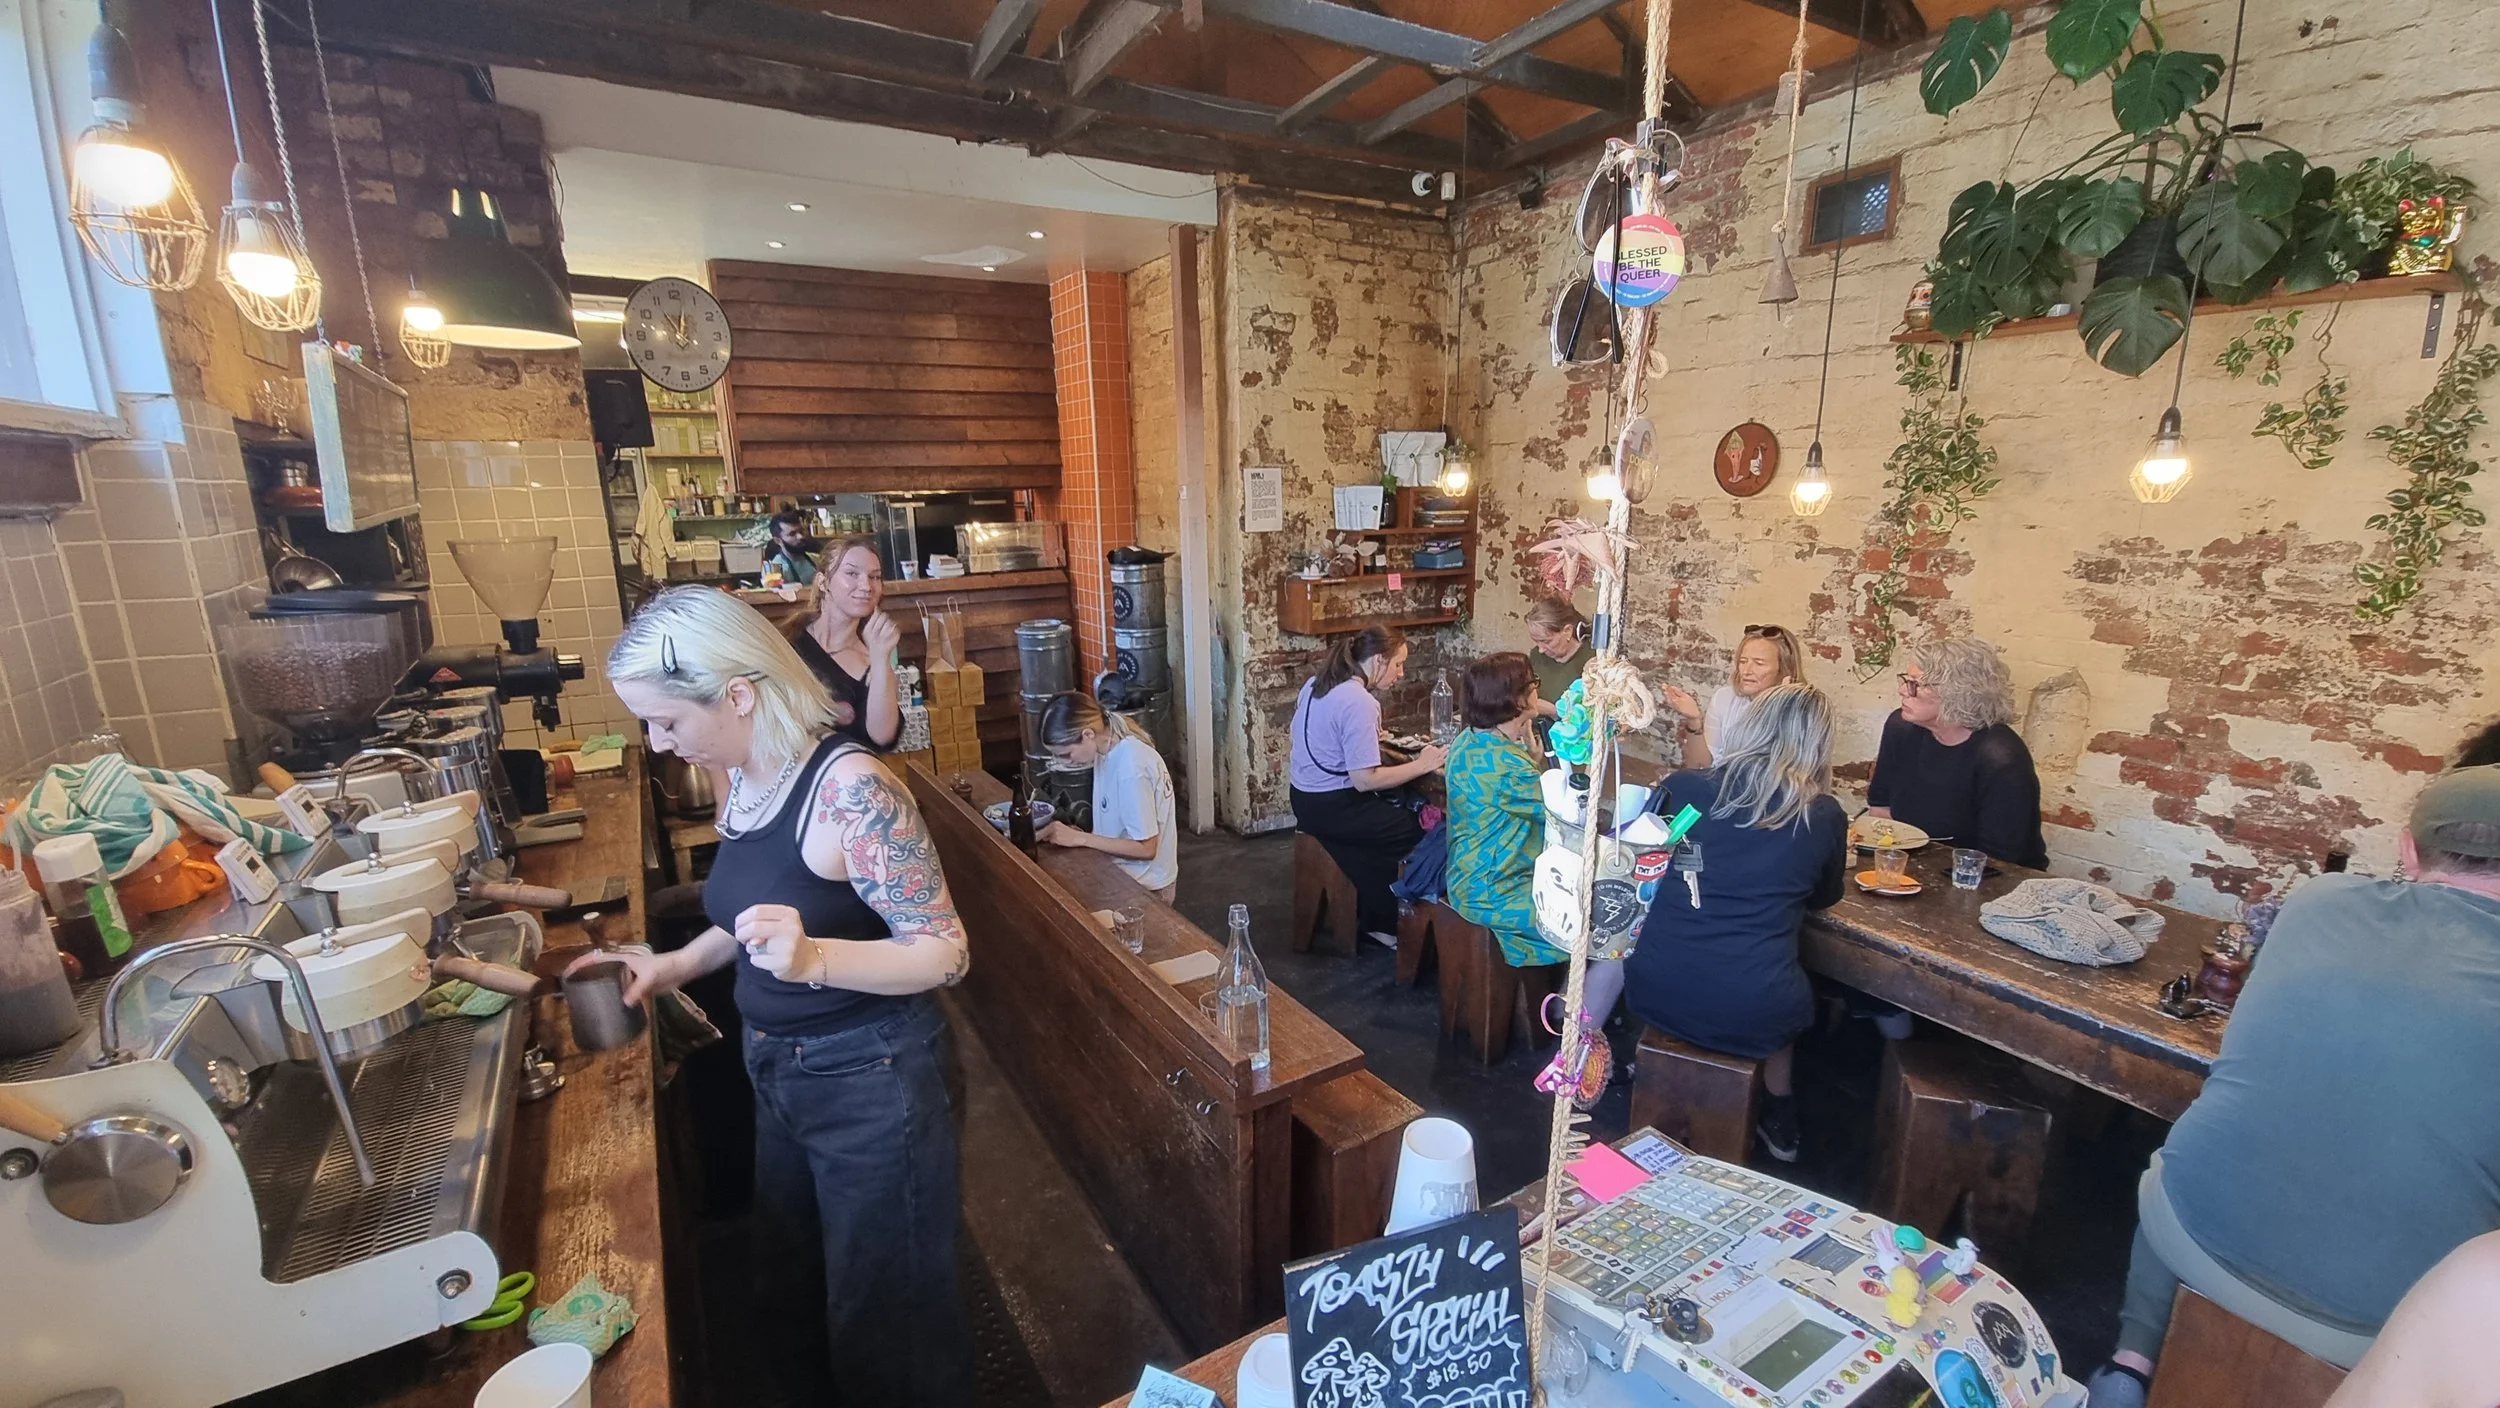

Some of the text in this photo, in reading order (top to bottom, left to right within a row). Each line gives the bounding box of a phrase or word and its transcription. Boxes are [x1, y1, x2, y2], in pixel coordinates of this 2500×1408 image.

[1618, 246, 1667, 261] LESSED
[1619, 257, 1661, 271] BE THE
[1620, 269, 1660, 283] QUEER
[668, 290, 680, 300] 12
[652, 296, 661, 306] 11
[640, 308, 652, 320] 10
[704, 312, 715, 322] 2
[712, 332, 722, 342] 3
[644, 350, 654, 360] 8
[662, 366, 671, 376] 7
[699, 365, 709, 375] 5
[681, 371, 691, 381] 6
[1426, 1351, 1492, 1390] $18.50
